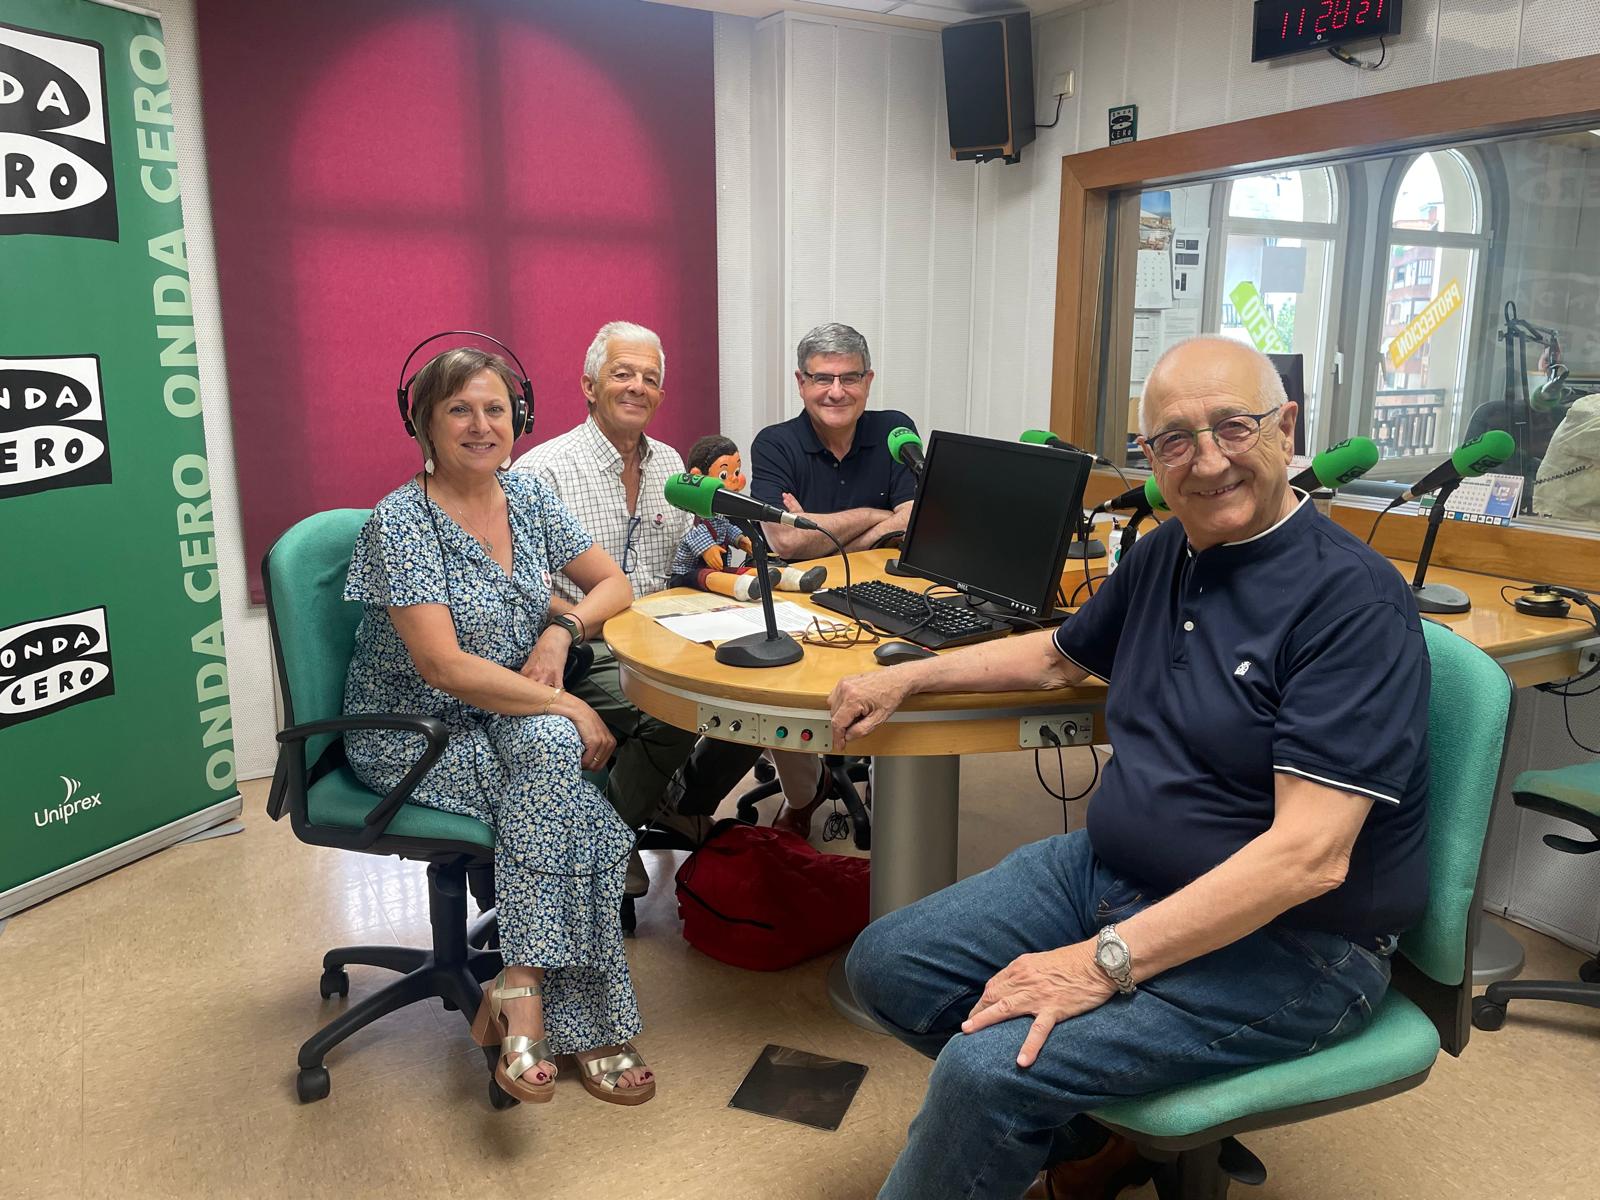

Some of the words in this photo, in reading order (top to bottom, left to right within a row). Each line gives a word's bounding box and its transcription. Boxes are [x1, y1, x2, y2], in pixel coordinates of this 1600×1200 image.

[1281, 8, 1306, 39] 11
[1315, 0, 1351, 33] 28
[1355, 0, 1384, 24] 21
[129, 34, 182, 203] CERO
[5, 152, 77, 200] RO
[147, 230, 203, 419] ONDA
[172, 453, 221, 603] CERO
[0, 631, 91, 669] ONDA
[10, 667, 94, 706] CERO
[191, 618, 237, 791] ONDA
[34, 792, 102, 827] Uniprex
